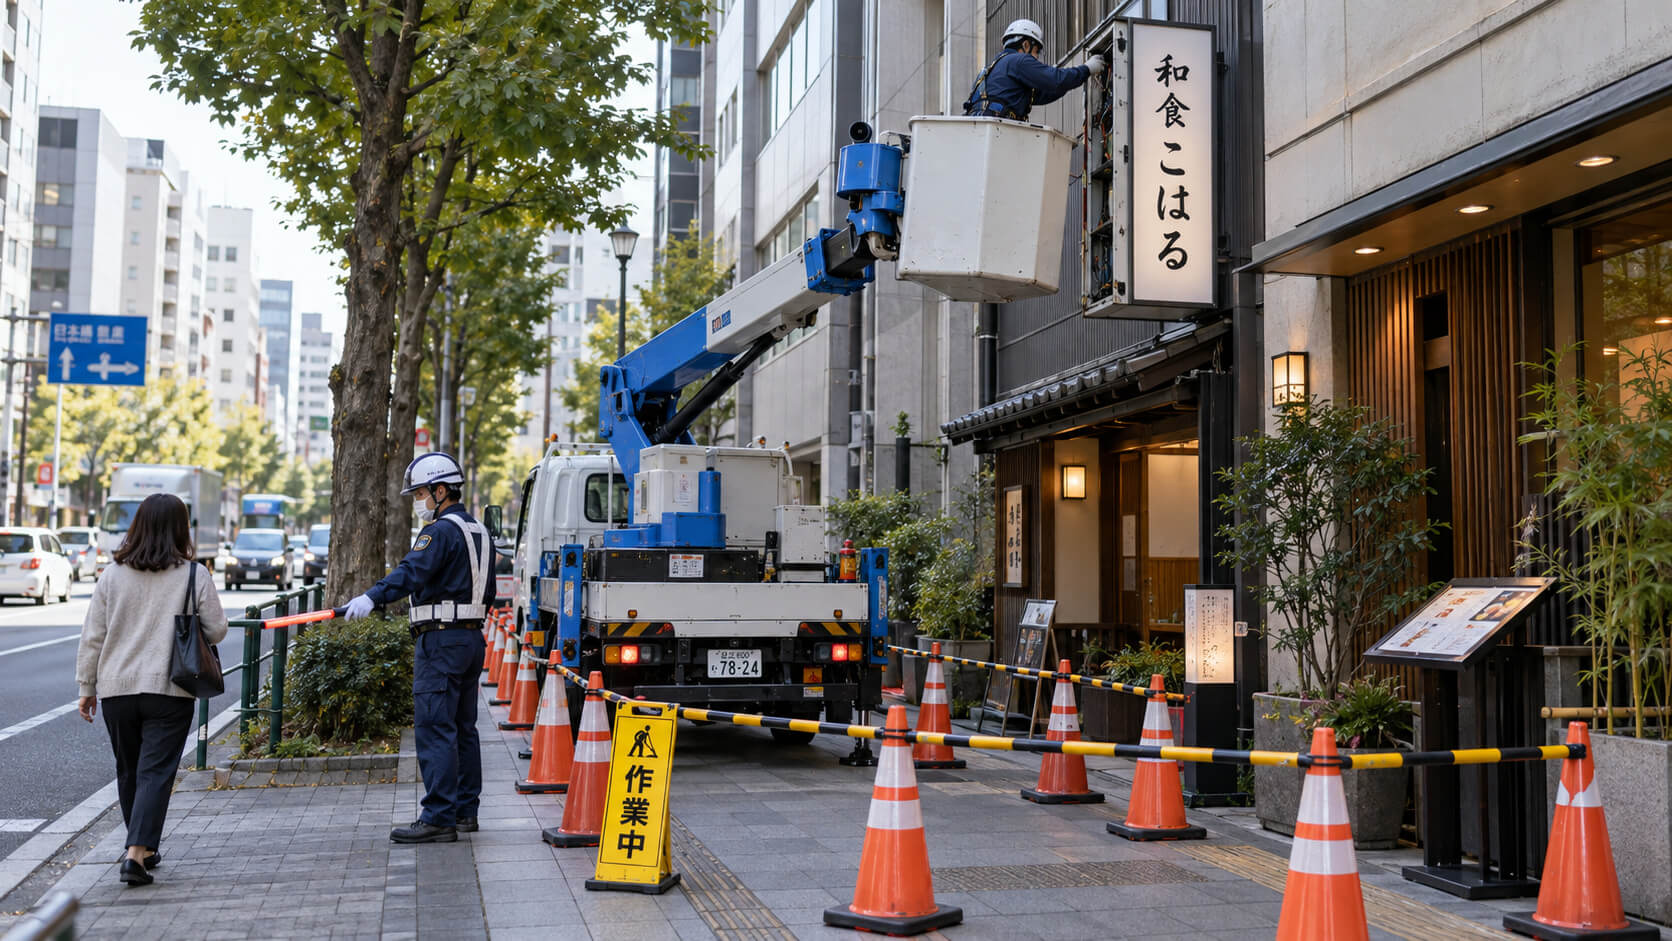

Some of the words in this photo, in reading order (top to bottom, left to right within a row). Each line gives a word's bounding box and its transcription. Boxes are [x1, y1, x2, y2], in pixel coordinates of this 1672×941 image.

[1154, 54, 1191, 271] 和食こはる
[720, 660, 758, 676] 78-24
[617, 765, 654, 859] 作業中
